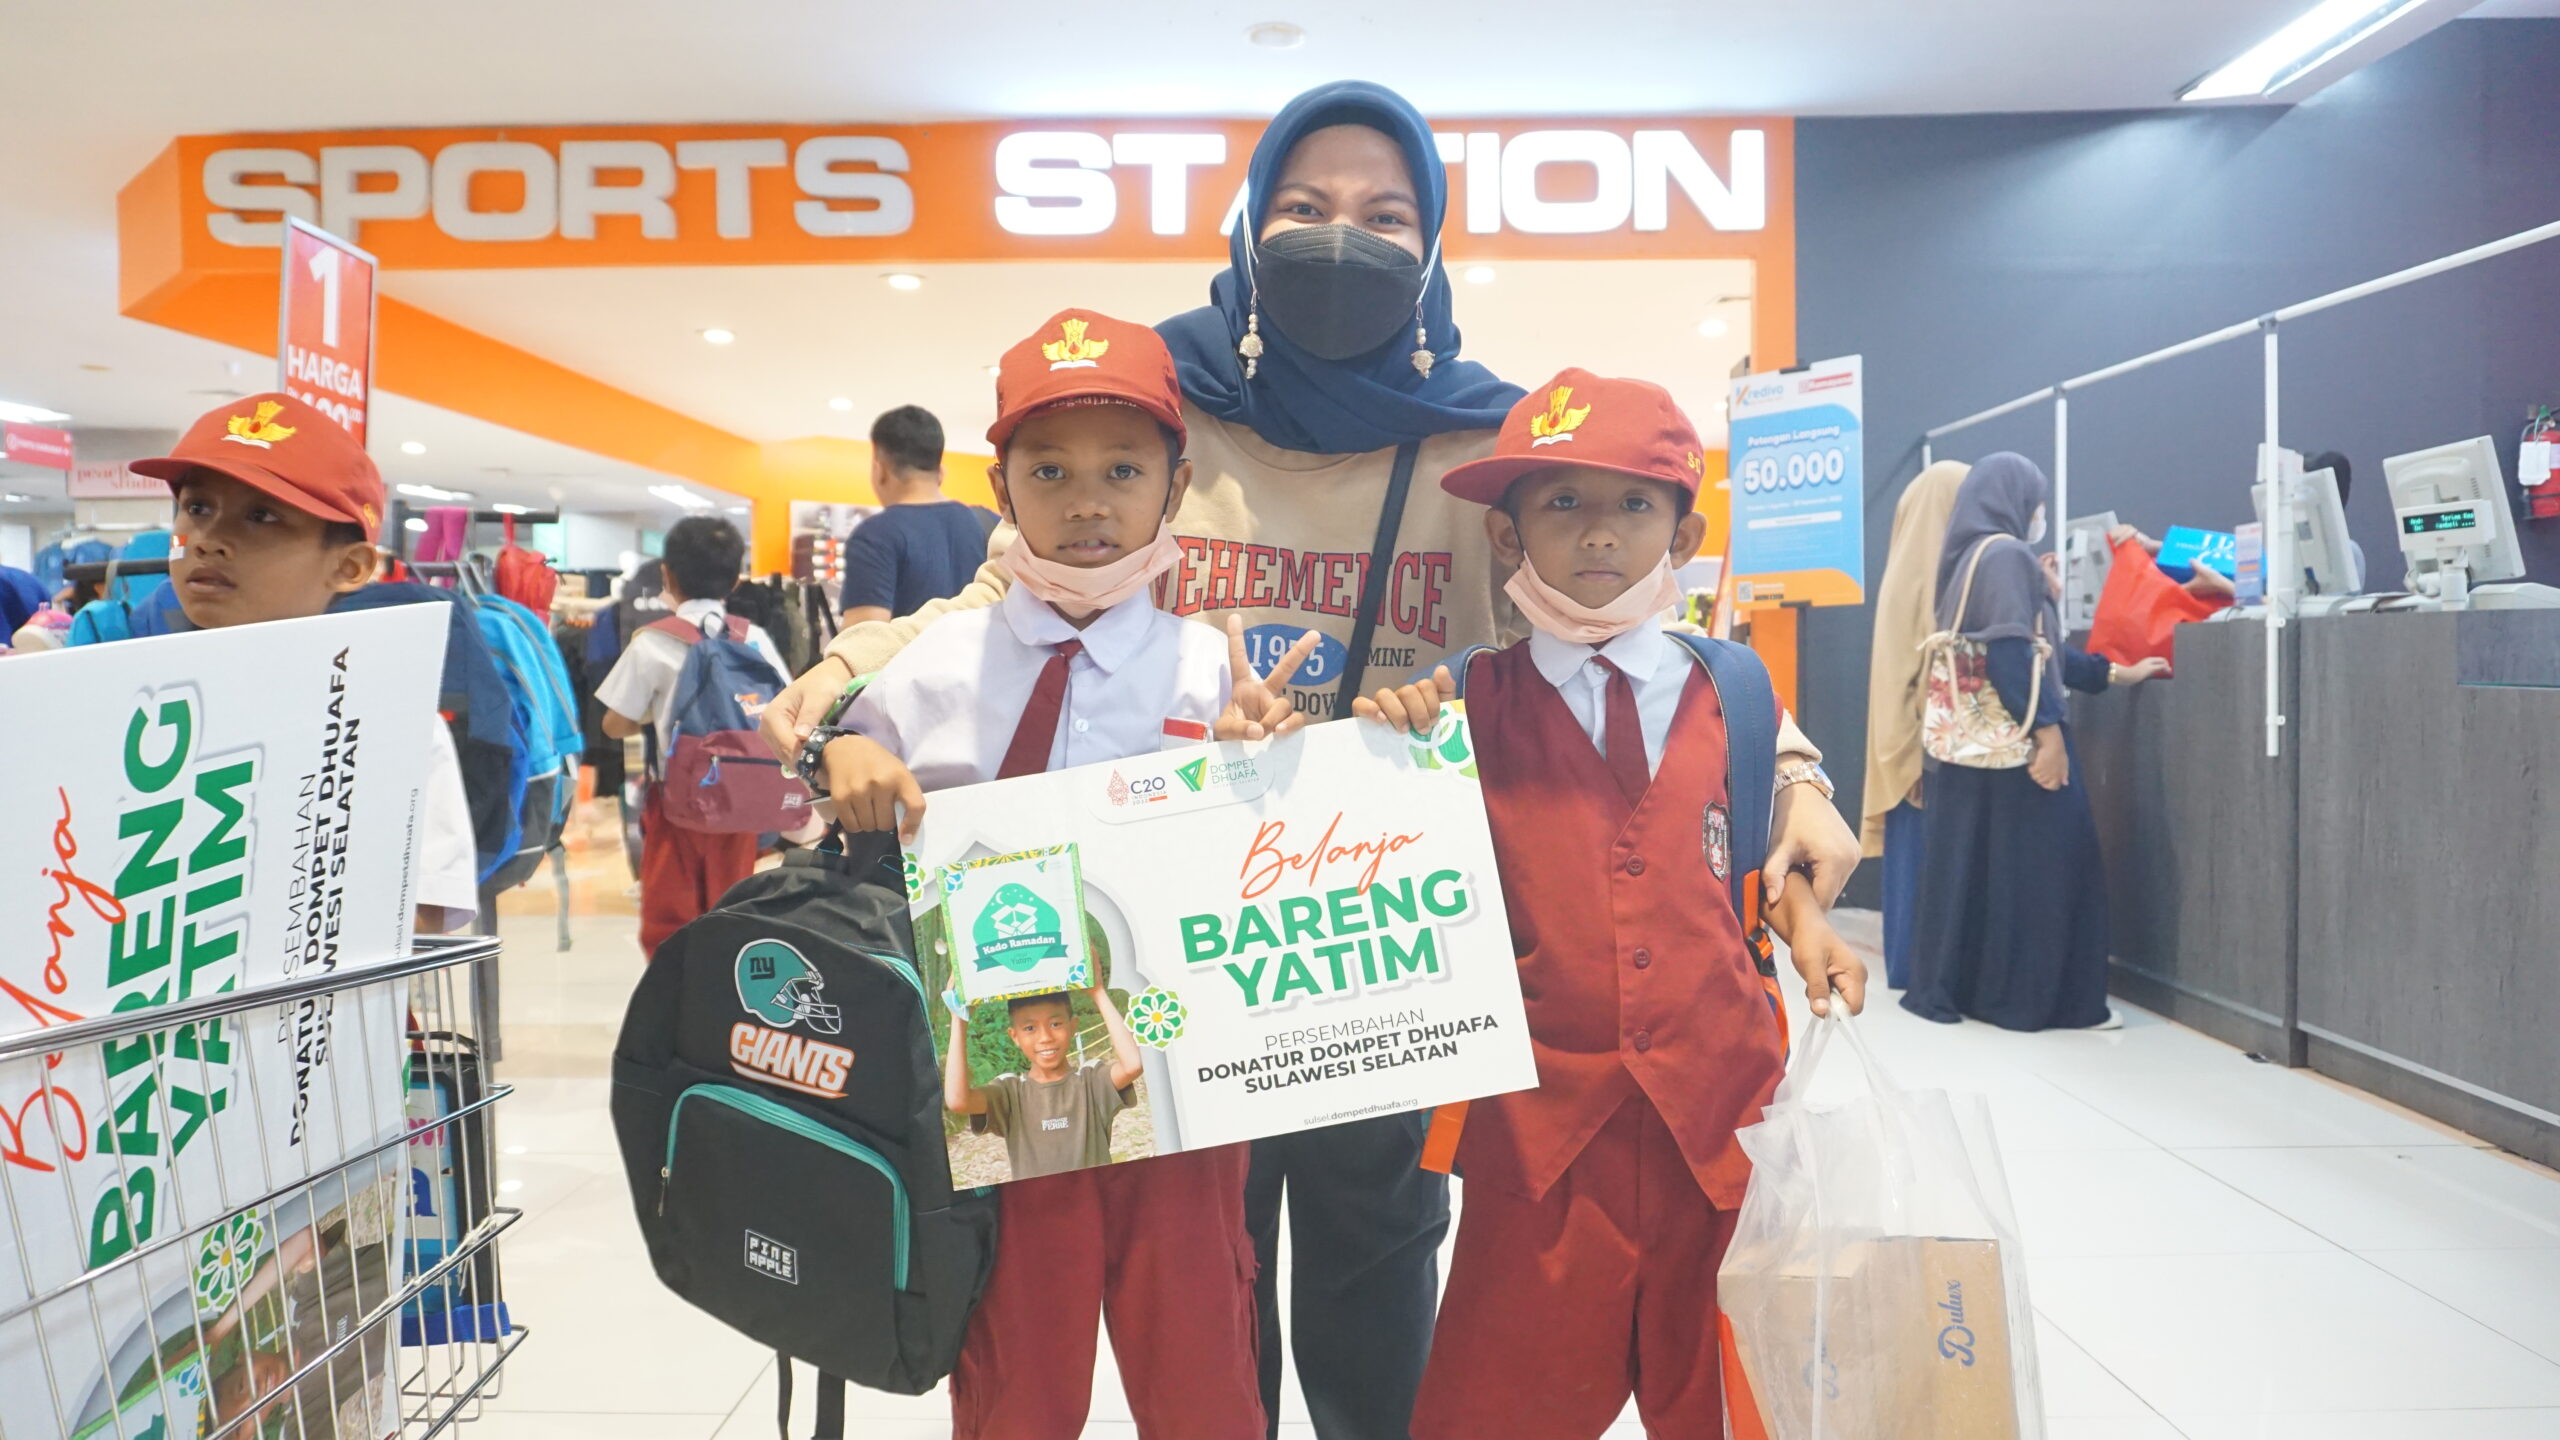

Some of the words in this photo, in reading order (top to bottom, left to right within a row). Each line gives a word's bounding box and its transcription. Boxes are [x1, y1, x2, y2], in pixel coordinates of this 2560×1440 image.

[202, 136, 914, 247] SPORTS
[994, 129, 1765, 236] STION
[308, 245, 341, 348] 1
[286, 343, 364, 401] HARGA
[1747, 432, 1791, 448] Potongan
[1792, 425, 1841, 441] Langsung
[1744, 448, 1844, 493] 50.000
[1251, 633, 1325, 677] 195
[1209, 757, 1257, 775] DOMPET
[1212, 768, 1259, 785] DHUAFA
[331, 718, 360, 878] SELATAN
[1240, 811, 1424, 899] Belanja
[289, 998, 315, 1147] DONATU
[304, 813, 331, 966] DOMPET
[318, 646, 350, 802] DHUAFA
[1179, 869, 1469, 964] BARENG
[982, 942, 1009, 955] Kado
[1009, 935, 1056, 949] Ramadan
[1222, 927, 1440, 1007] YATIM
[730, 1021, 855, 1093] GIANTS
[1197, 1050, 1305, 1083] DONATUR
[1307, 1032, 1402, 1063] DOMPET
[1408, 1014, 1498, 1045] DHUAFA
[1265, 1008, 1425, 1051] PERSEMBAHAN
[1244, 1060, 1357, 1094] SULAWESI
[1363, 1041, 1458, 1073] SELATAN
[1303, 1098, 1419, 1127] sulsel.dompetdhuafa.org
[749, 1236, 793, 1265] PINE
[749, 1251, 792, 1278] APPLE
[1937, 1279, 1975, 1367] Dulux
